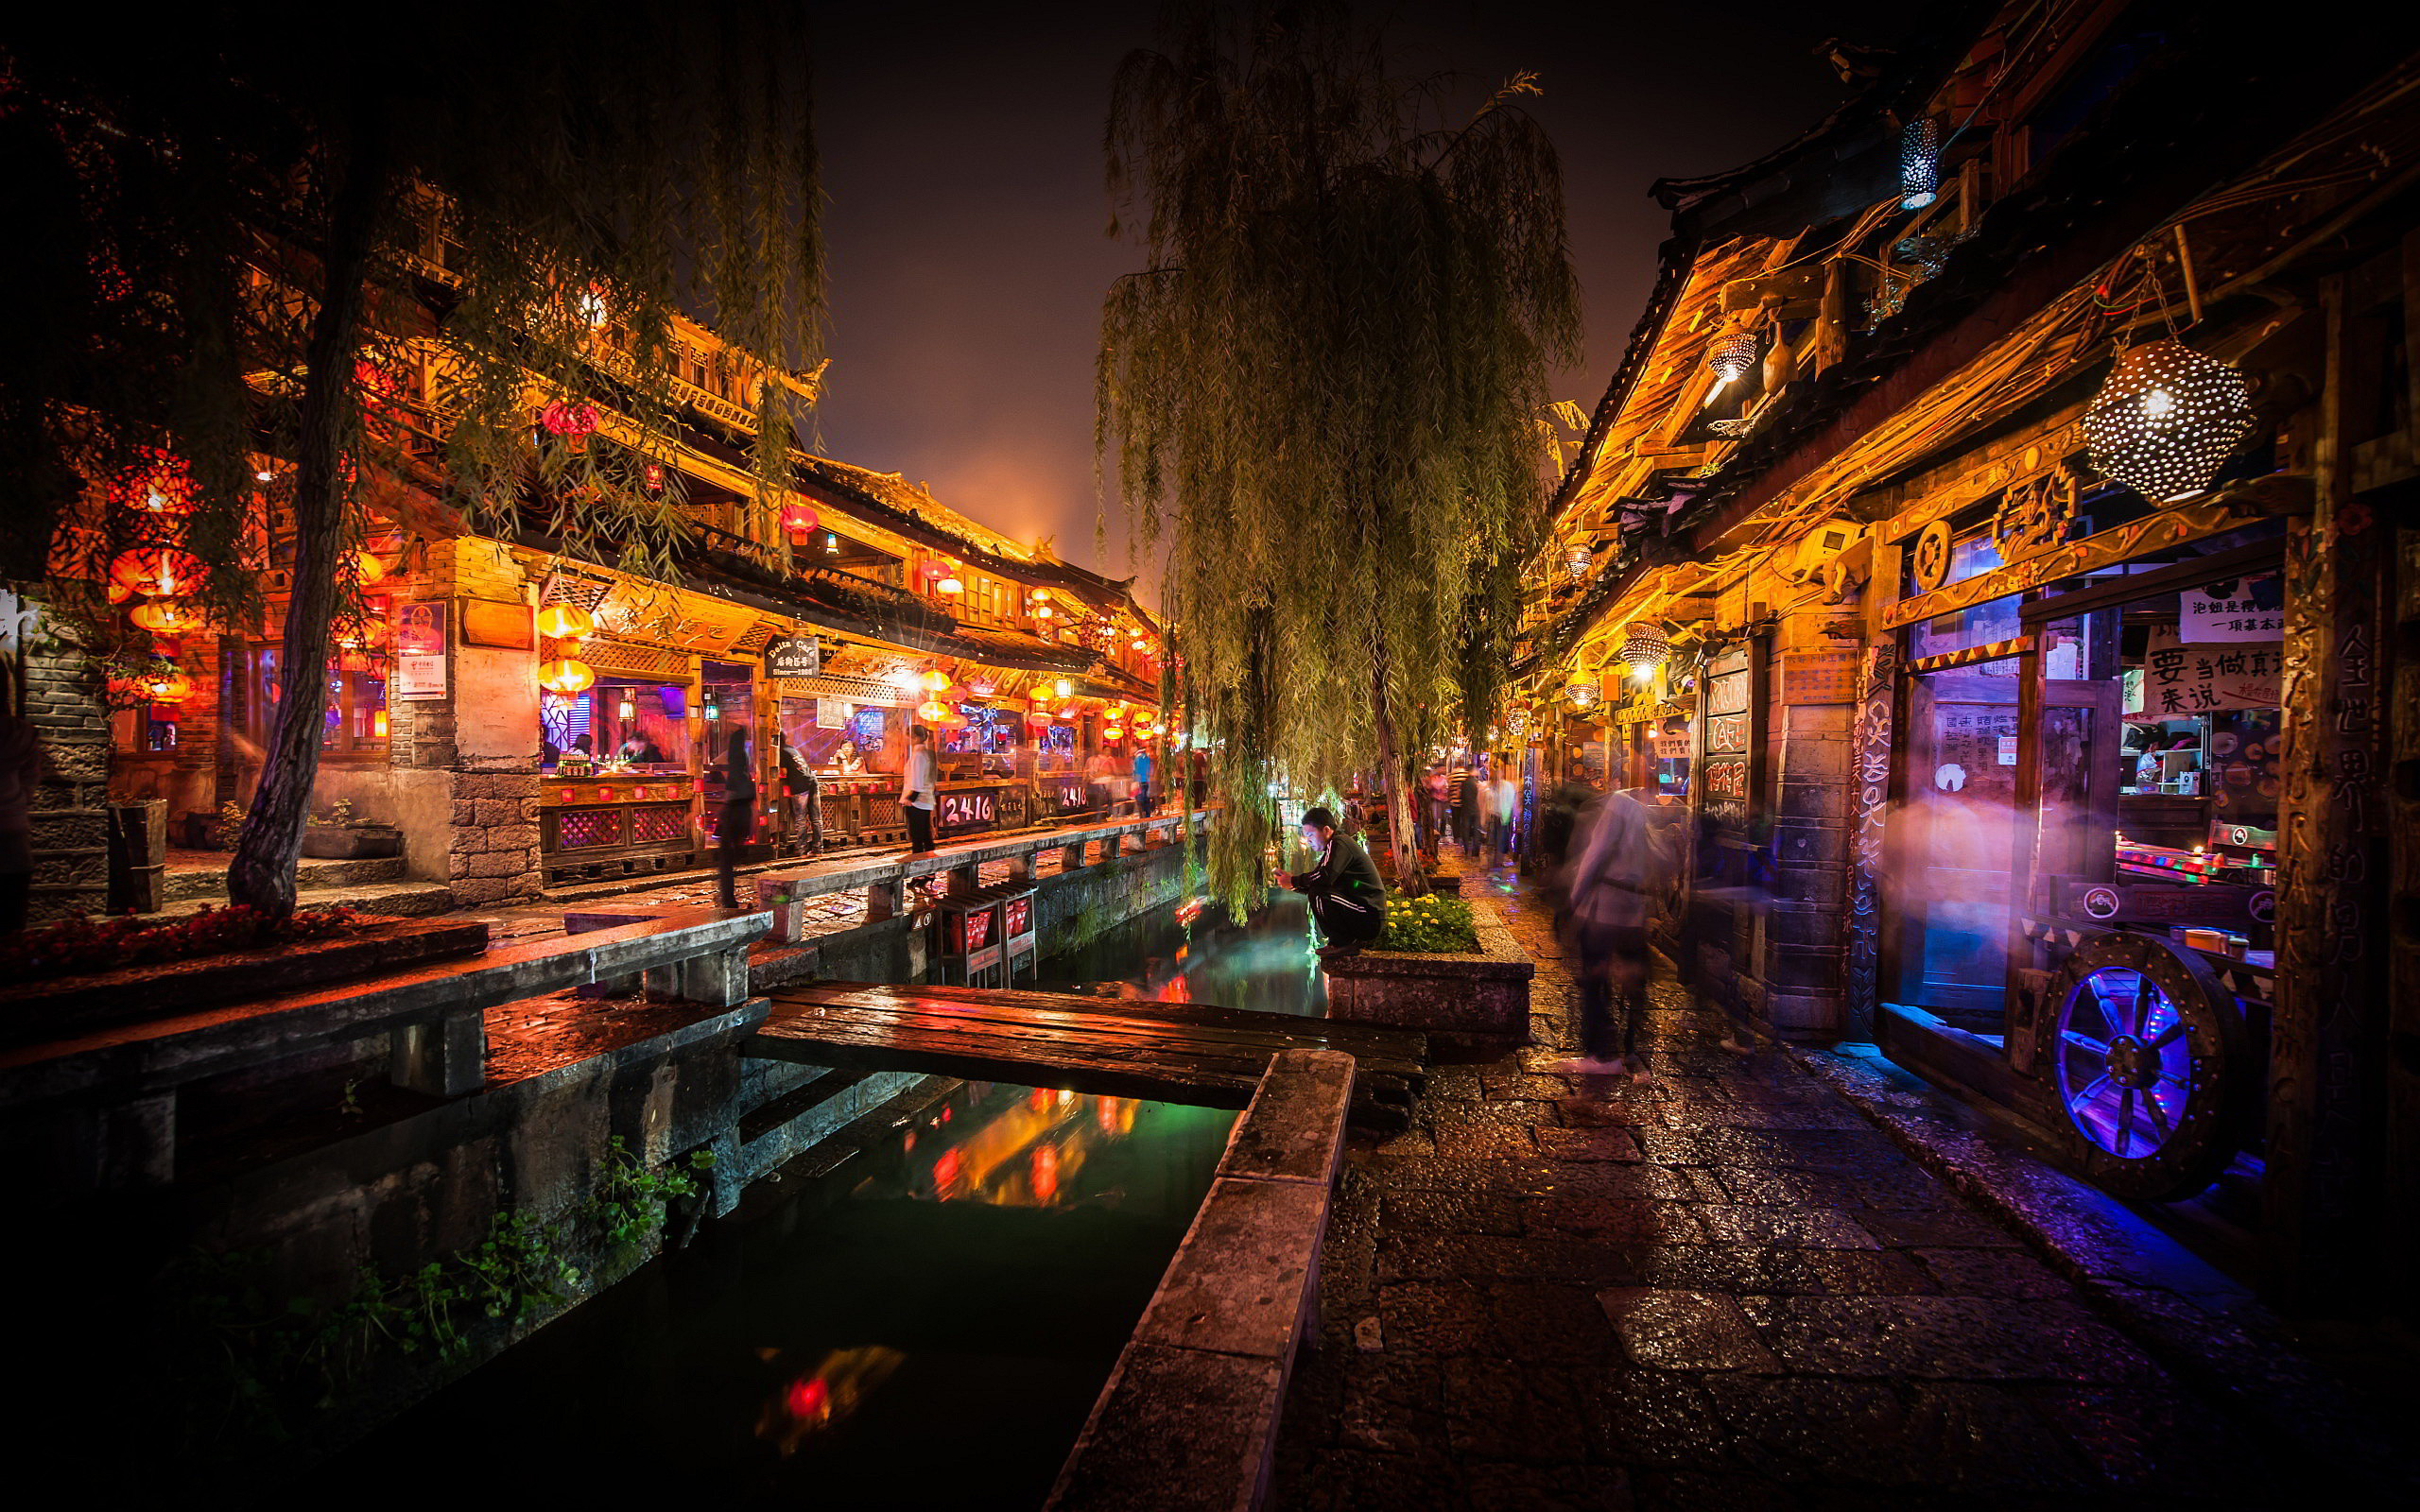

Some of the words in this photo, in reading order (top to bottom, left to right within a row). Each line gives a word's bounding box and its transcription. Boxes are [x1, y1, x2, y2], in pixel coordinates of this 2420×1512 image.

[768, 641, 791, 659] Delta
[962, 663, 1018, 689] 2416
[1711, 716, 1745, 751] CAFE
[945, 795, 991, 823] 2416
[1062, 786, 1086, 807] 2416
